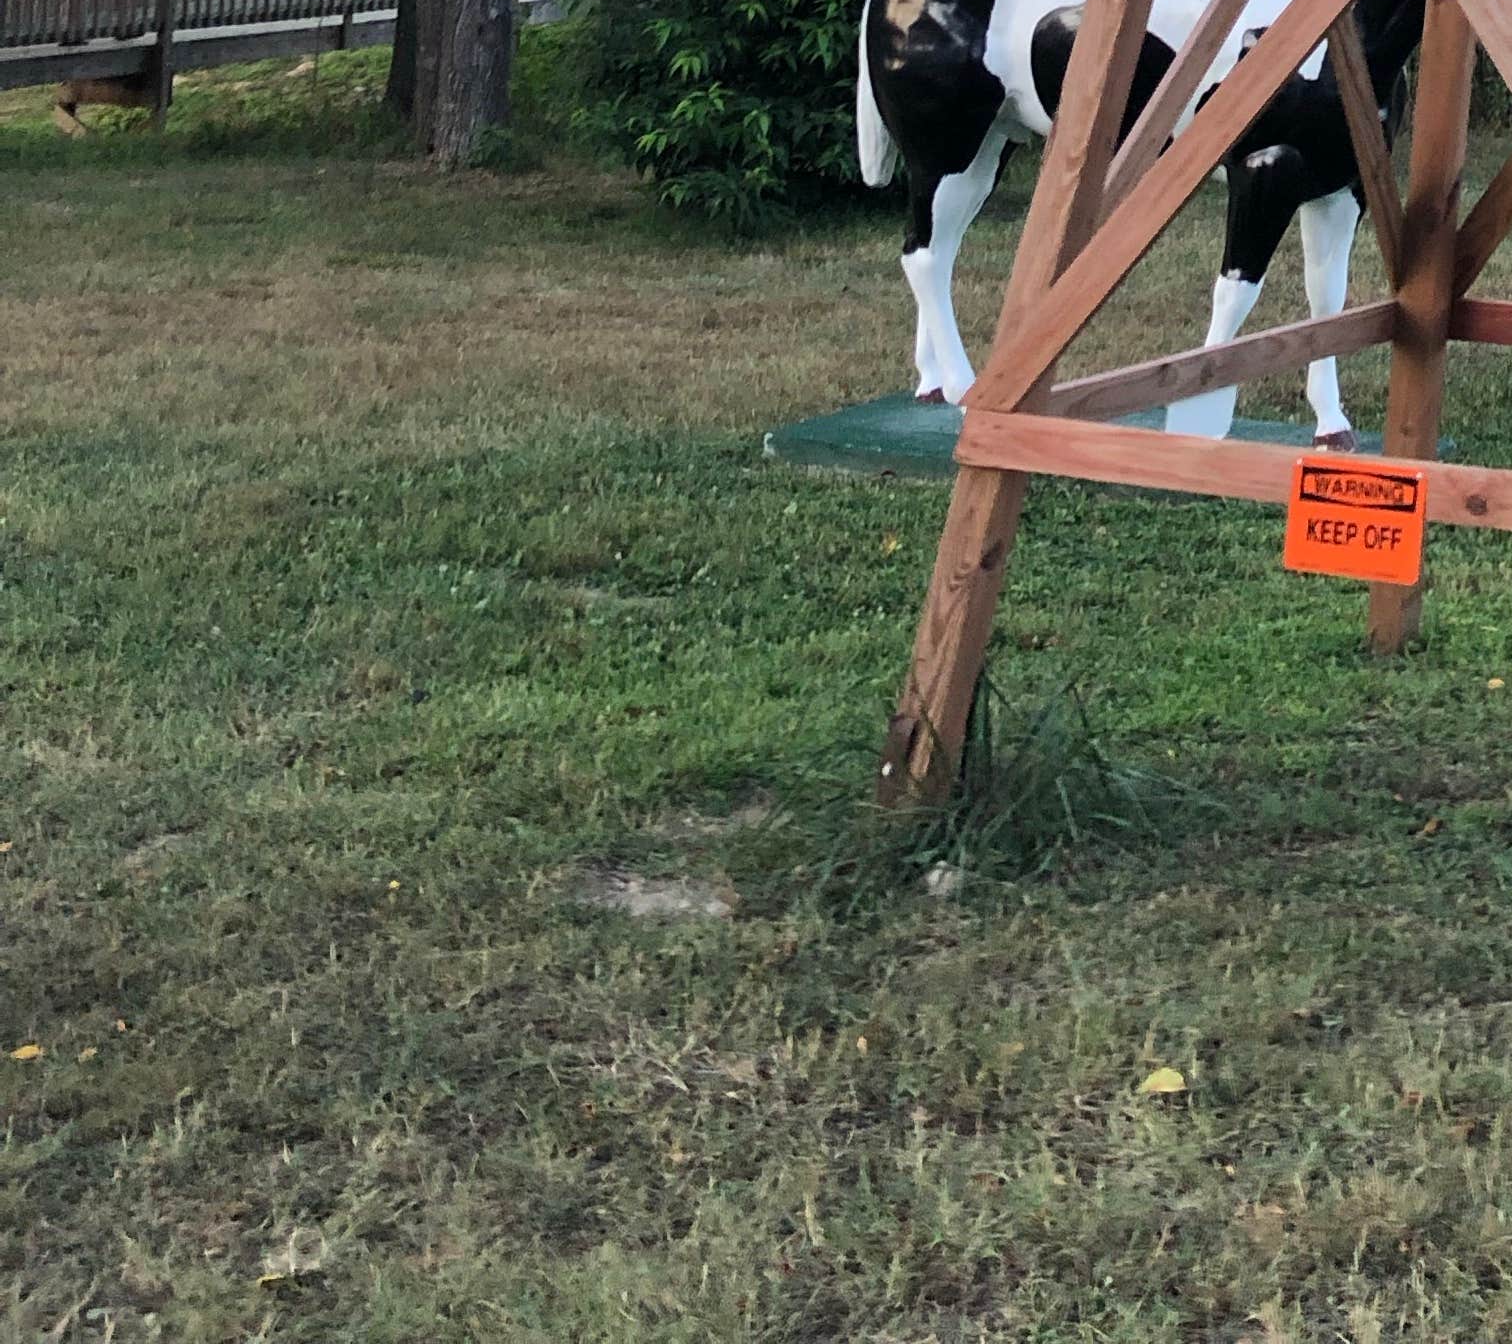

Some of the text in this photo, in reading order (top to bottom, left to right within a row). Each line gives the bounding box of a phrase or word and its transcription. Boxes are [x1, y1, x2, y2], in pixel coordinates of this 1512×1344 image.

[1314, 474, 1404, 504] WARNING
[1306, 518, 1403, 551] KEEP OFF
